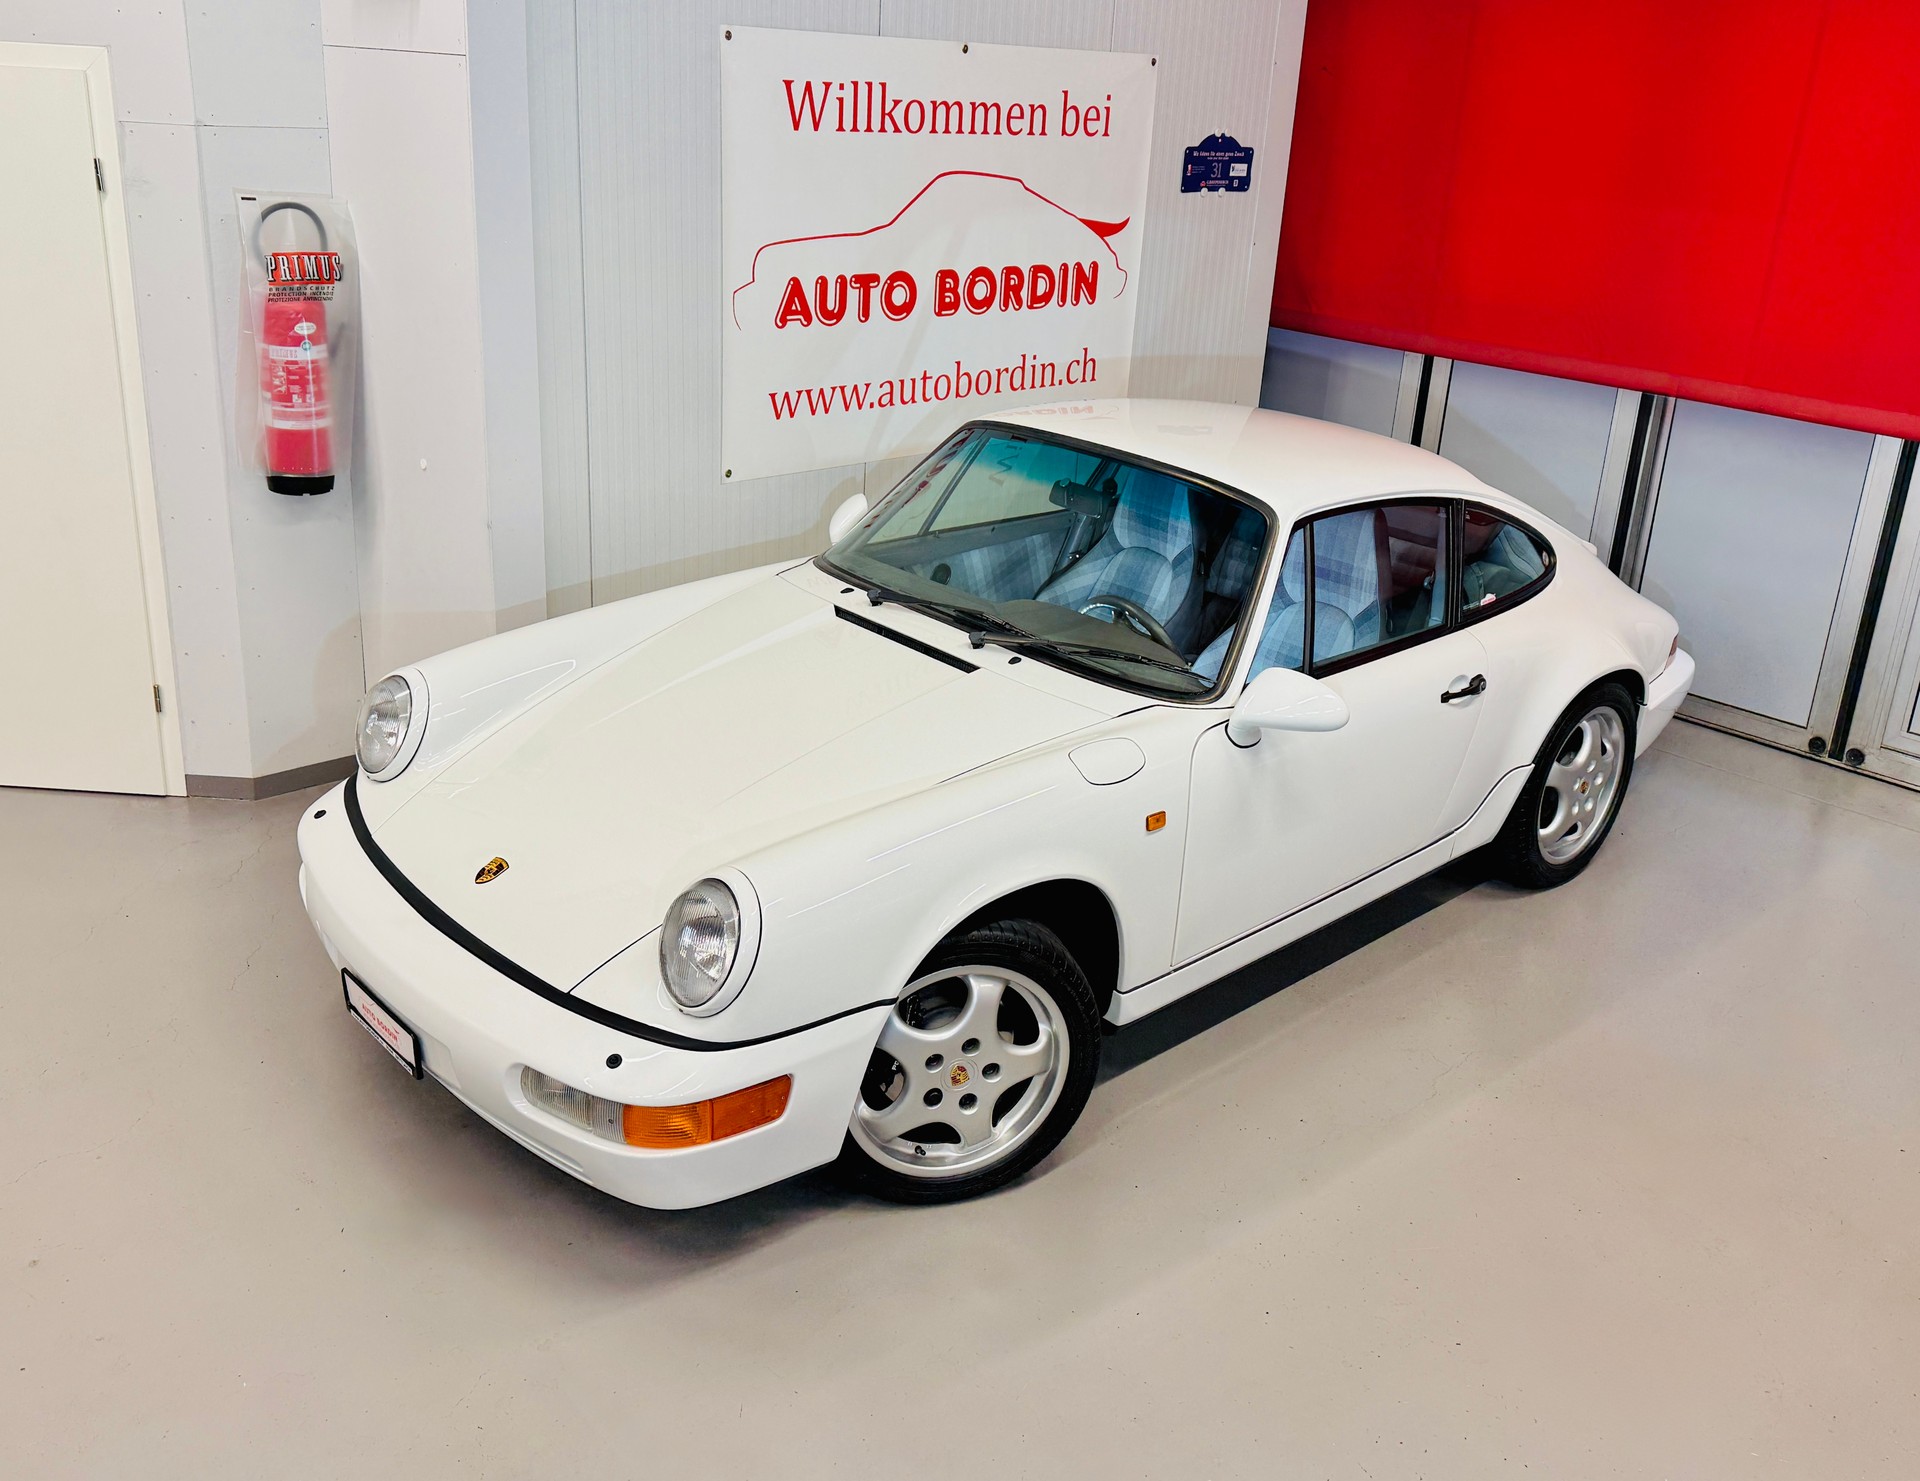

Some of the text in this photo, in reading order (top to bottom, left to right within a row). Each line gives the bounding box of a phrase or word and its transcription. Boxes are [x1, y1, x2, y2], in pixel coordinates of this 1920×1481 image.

[783, 79, 1112, 138] Willkommen bei
[1211, 162, 1222, 178] 31
[264, 254, 342, 282] PRIMUS
[774, 260, 1099, 329] AUTO BORDIN
[768, 347, 1098, 421] www.autobordin.ch
